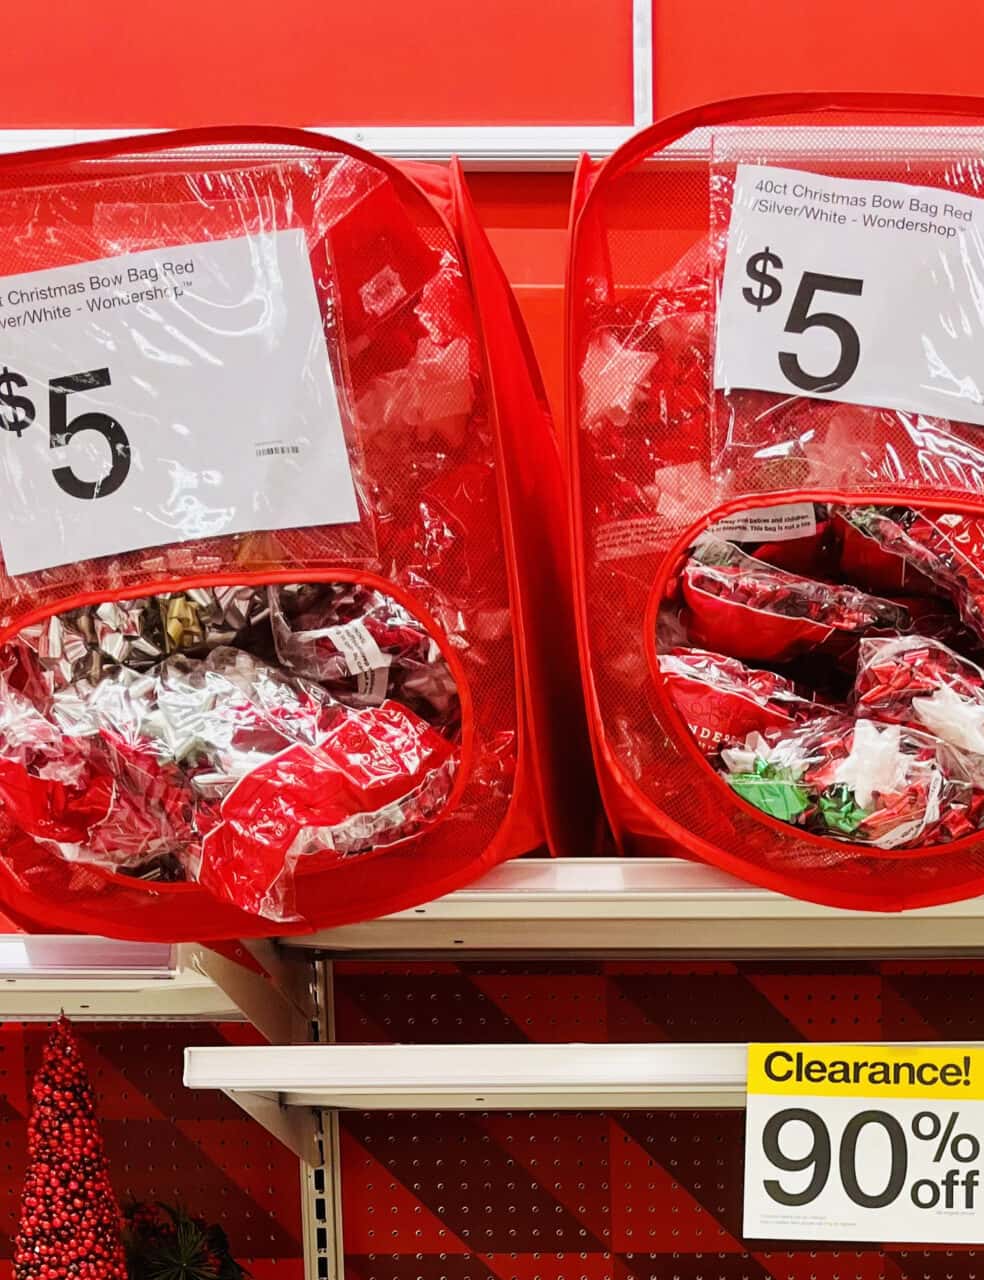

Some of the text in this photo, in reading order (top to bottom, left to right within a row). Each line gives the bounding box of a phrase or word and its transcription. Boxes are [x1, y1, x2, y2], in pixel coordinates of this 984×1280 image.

[752, 199, 847, 225] /Silver/White
[755, 180, 972, 222] 40ct Christmas Bow Bag Red
[8, 259, 194, 305] Christmas Bow Bag Red
[764, 1051, 971, 1086] Clearance!
[762, 1108, 980, 1209] 90%
[911, 1169, 980, 1209] off
